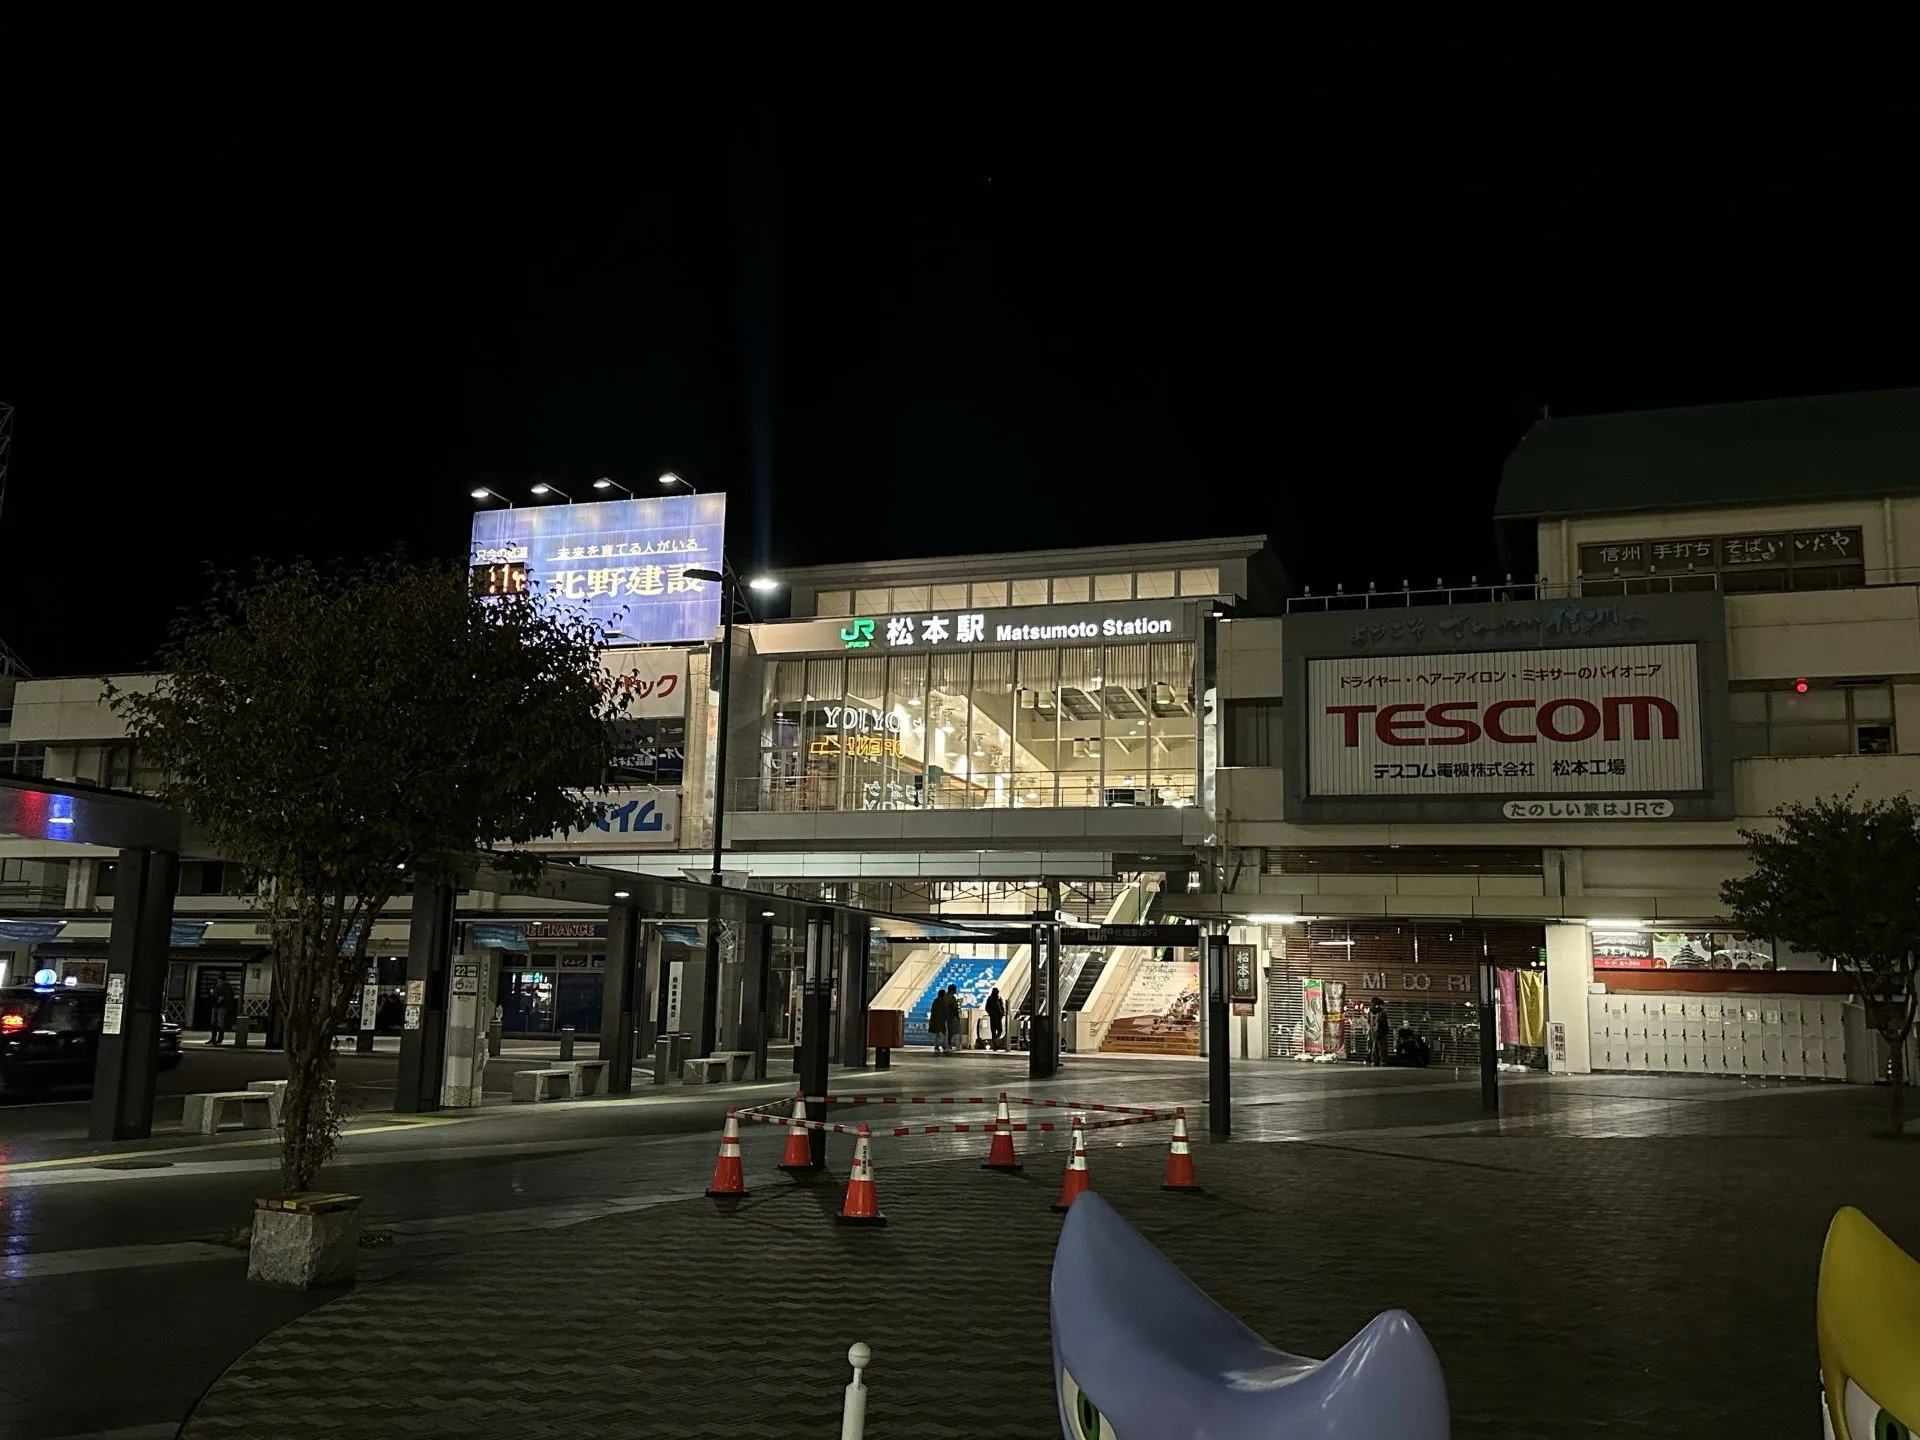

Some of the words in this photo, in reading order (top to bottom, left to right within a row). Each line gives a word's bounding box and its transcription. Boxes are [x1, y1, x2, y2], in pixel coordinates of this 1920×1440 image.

[475, 547, 528, 561] 只今の
[556, 538, 698, 560] 未来を育てる人がいる
[1600, 546, 1641, 563] 信州
[1653, 542, 1711, 559] 手打ち
[1725, 539, 1763, 555] そば
[546, 562, 706, 600] 北野建設
[840, 619, 875, 641] JR
[886, 613, 984, 645] 松本駅
[996, 620, 1098, 642] Matsumoto
[1102, 617, 1172, 636] Station
[1350, 616, 1426, 644] ようこそ
[1326, 695, 1680, 748] TESCOM
[1373, 761, 1536, 779] テスコム電機株式会社
[1552, 759, 1626, 777] 松本工場
[1510, 801, 1665, 817] たのしい旅はJRで
[455, 966, 467, 976] 22
[1554, 1025, 1564, 1061] 駐輪禁止
